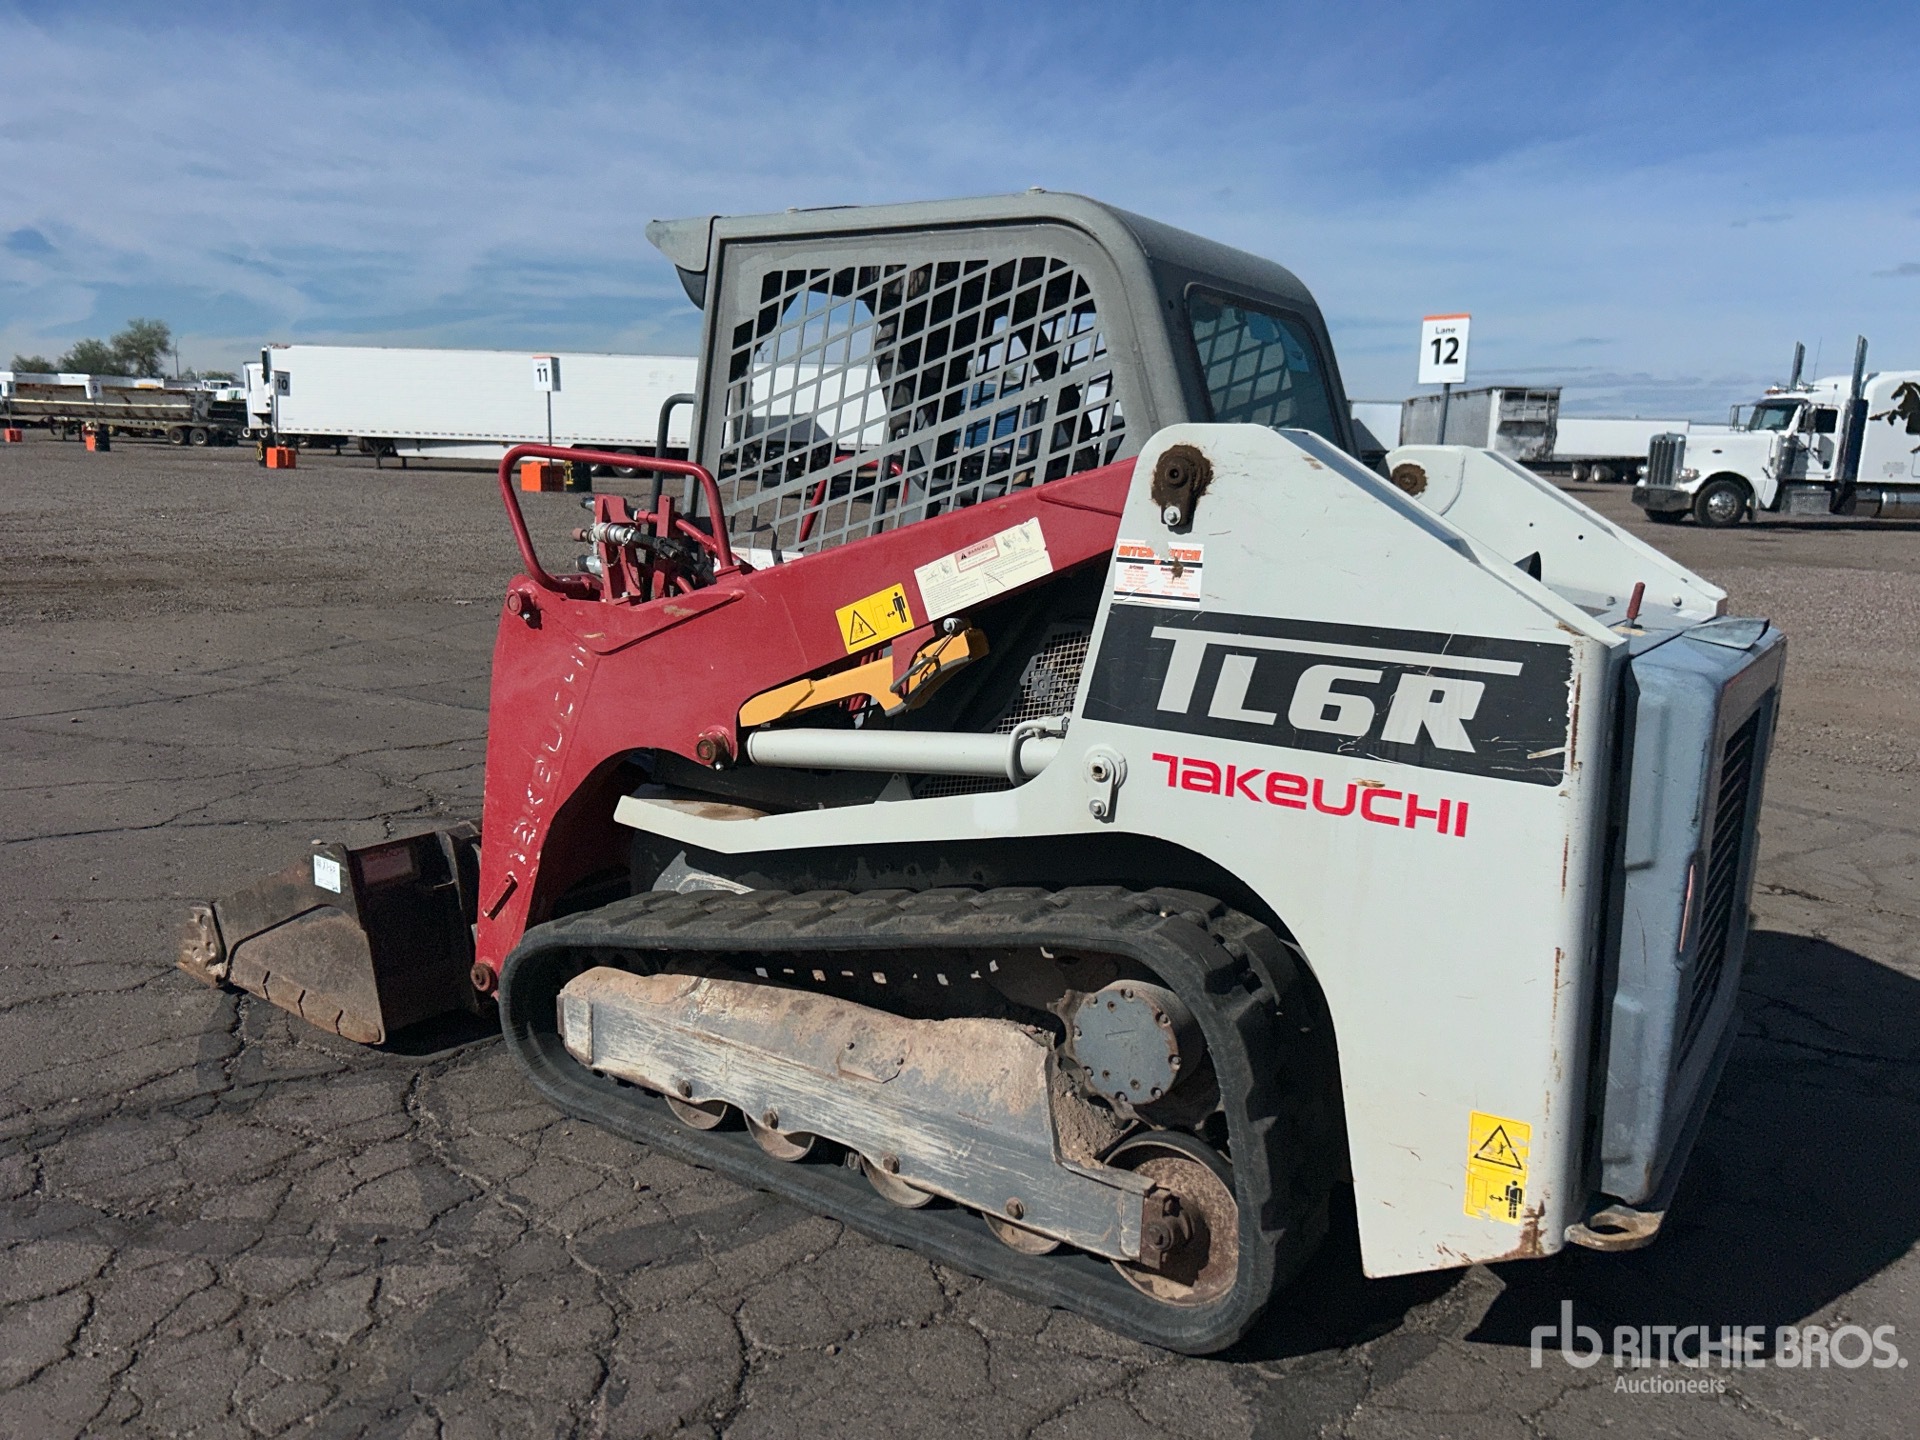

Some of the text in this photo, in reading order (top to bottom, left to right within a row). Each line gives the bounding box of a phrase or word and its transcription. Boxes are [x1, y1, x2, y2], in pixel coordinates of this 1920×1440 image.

[1435, 326, 1456, 335] Lane
[1430, 336, 1460, 365] 12
[536, 367, 549, 383] 11
[276, 378, 289, 391] 10
[1151, 626, 1524, 753] TL6R
